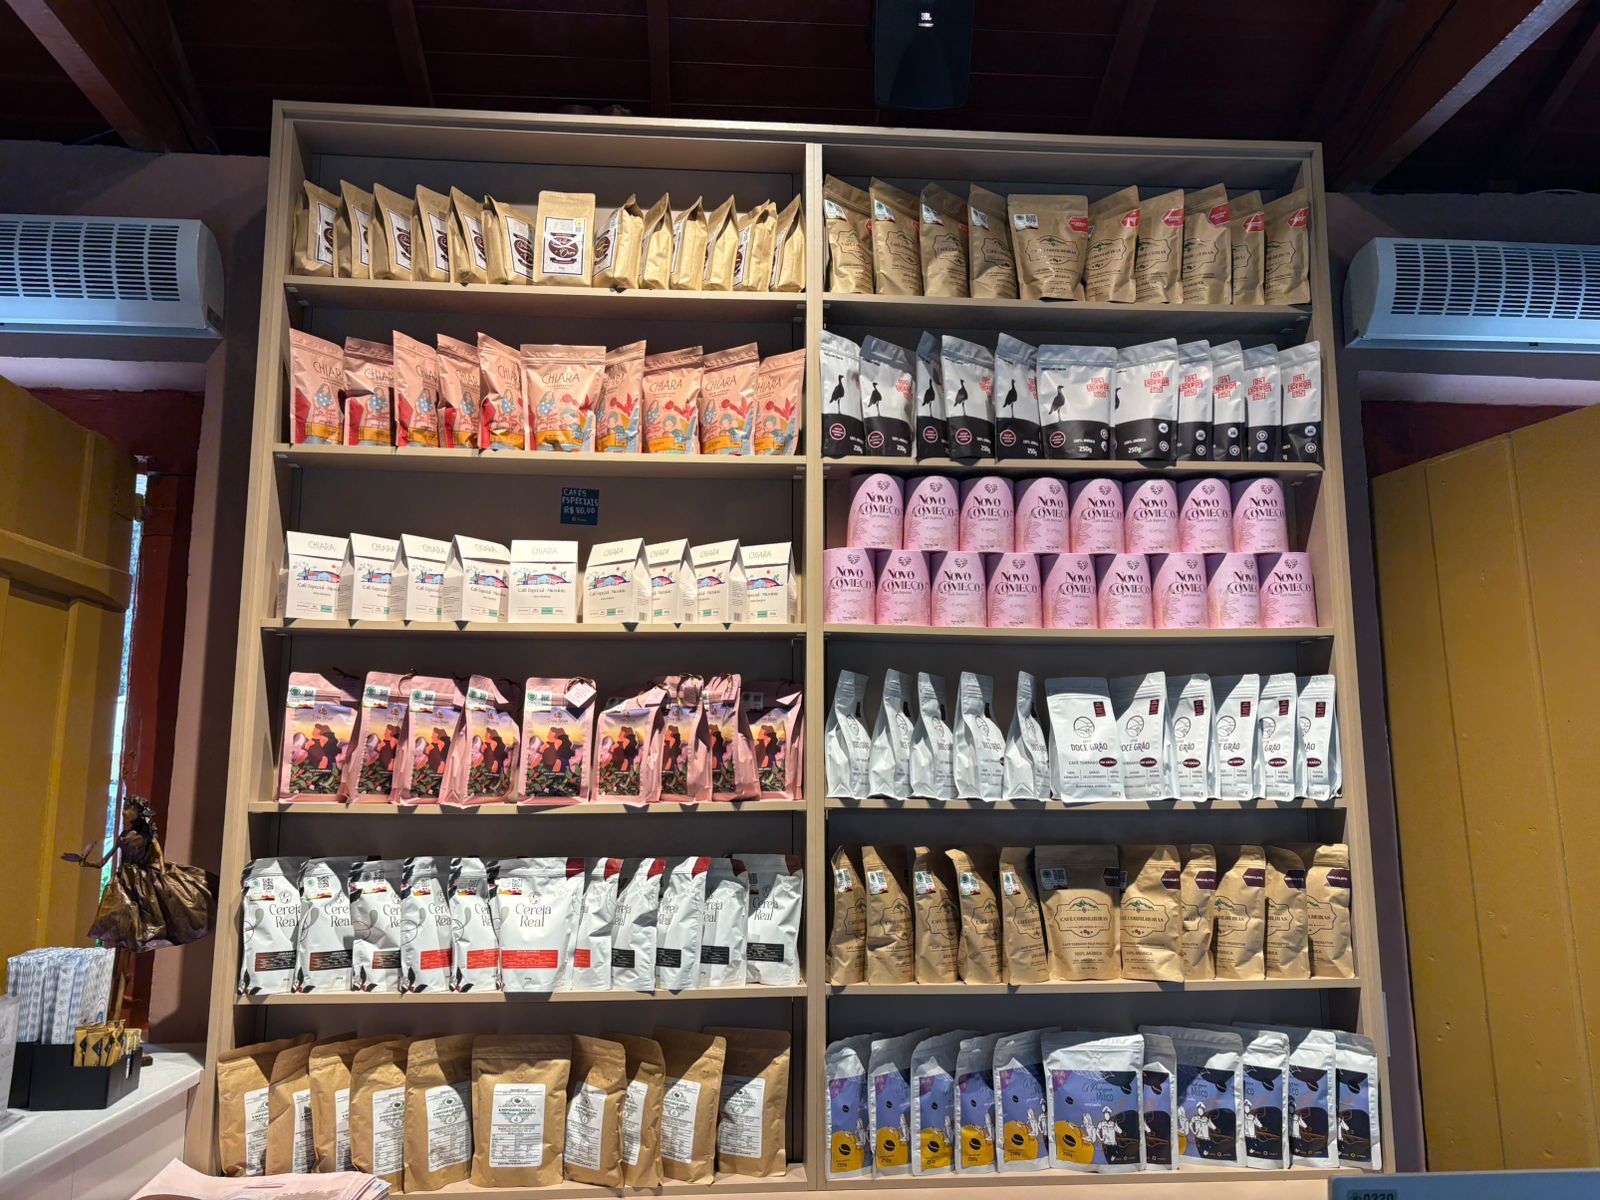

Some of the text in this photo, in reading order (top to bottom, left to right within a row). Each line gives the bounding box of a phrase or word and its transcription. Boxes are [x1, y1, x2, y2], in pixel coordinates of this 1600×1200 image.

[313, 361, 343, 378] CHIAR
[364, 368, 394, 381] CHIAR
[455, 369, 480, 385] CHIAR
[541, 372, 580, 384] CHIARA
[705, 374, 737, 392] CHIARA
[649, 378, 682, 393] CHIARA
[757, 376, 782, 393] HIARA
[1070, 742, 1108, 753] DOCE GRÃO
[1121, 742, 1150, 752] OCE GRÃO
[1178, 743, 1195, 753] GRÃO
[1223, 742, 1241, 753] GRÃO
[1264, 743, 1281, 753] GRÃO
[324, 903, 350, 916] Cere
[383, 903, 402, 916] Cer
[428, 902, 450, 914] Cere
[703, 900, 723, 912] ereja
[752, 897, 779, 910] Cereja
[515, 903, 552, 918] Cereja
[753, 909, 773, 921] Real
[330, 916, 350, 928] Rea
[390, 916, 402, 928] Re
[435, 915, 452, 927] Rea
[519, 915, 545, 928] Real
